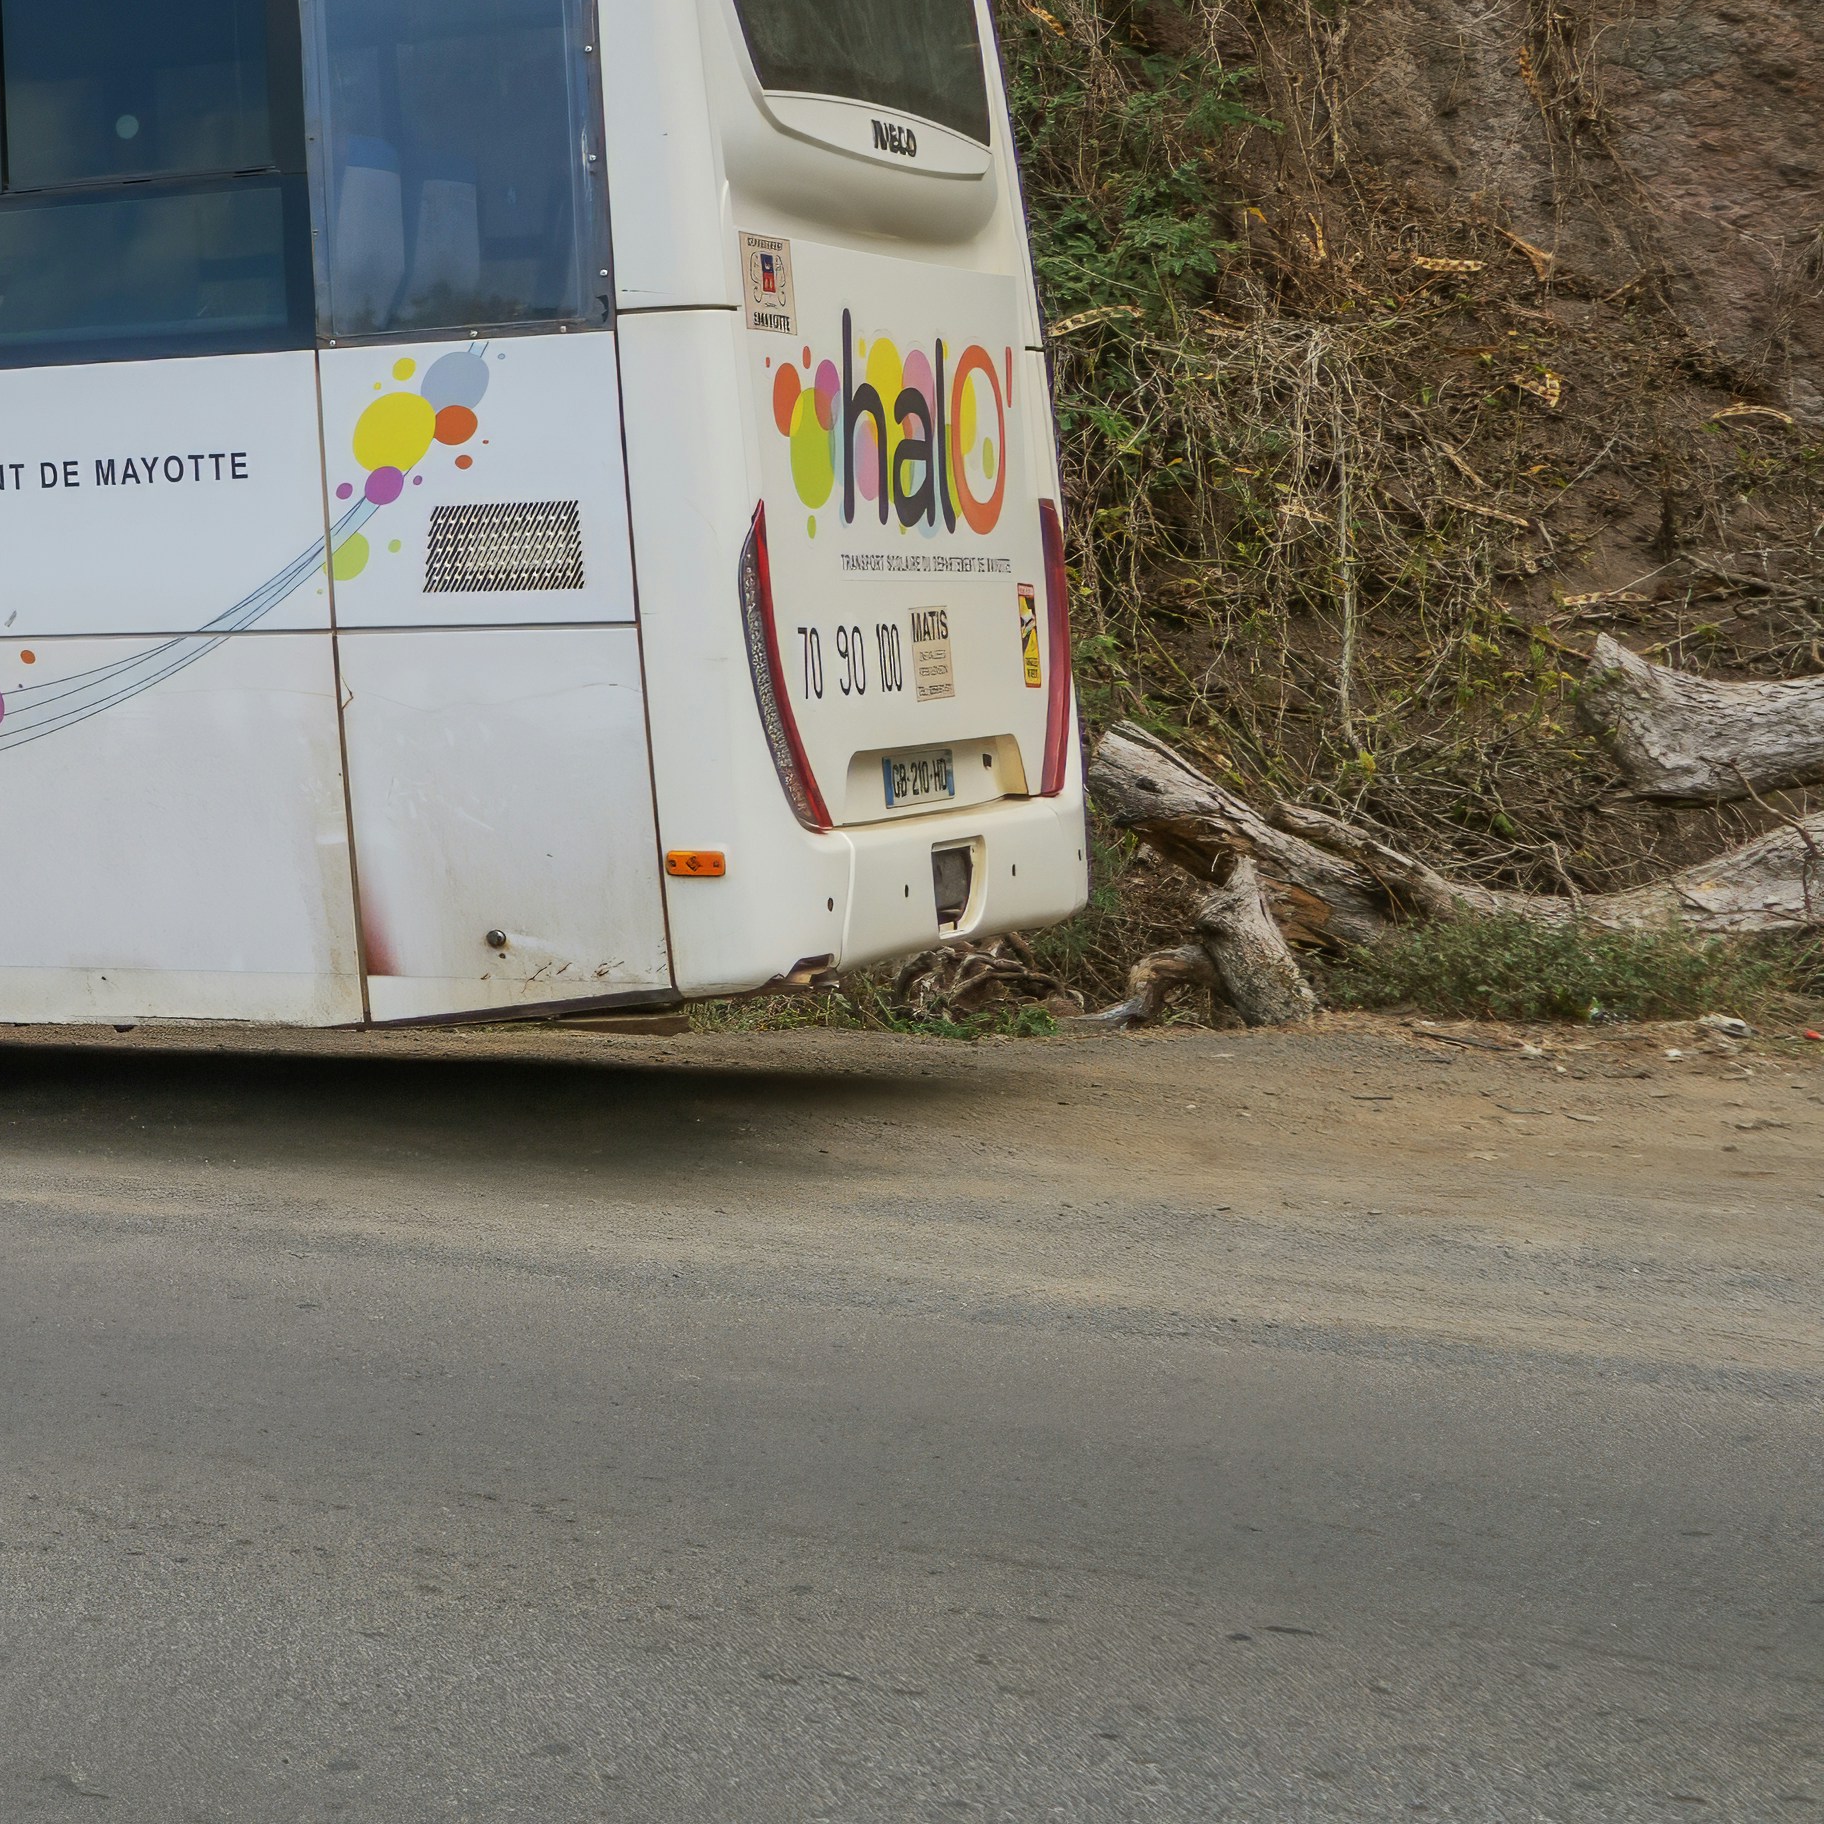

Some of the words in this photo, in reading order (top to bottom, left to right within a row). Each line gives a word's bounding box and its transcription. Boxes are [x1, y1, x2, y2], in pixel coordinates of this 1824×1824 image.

[870, 119, 918, 158] IVECO
[40, 460, 81, 489] DE
[95, 451, 250, 486] MAYOTTE
[911, 609, 949, 643] MATIS
[797, 626, 823, 700] 70
[836, 624, 866, 696] 90
[876, 623, 903, 693] 100
